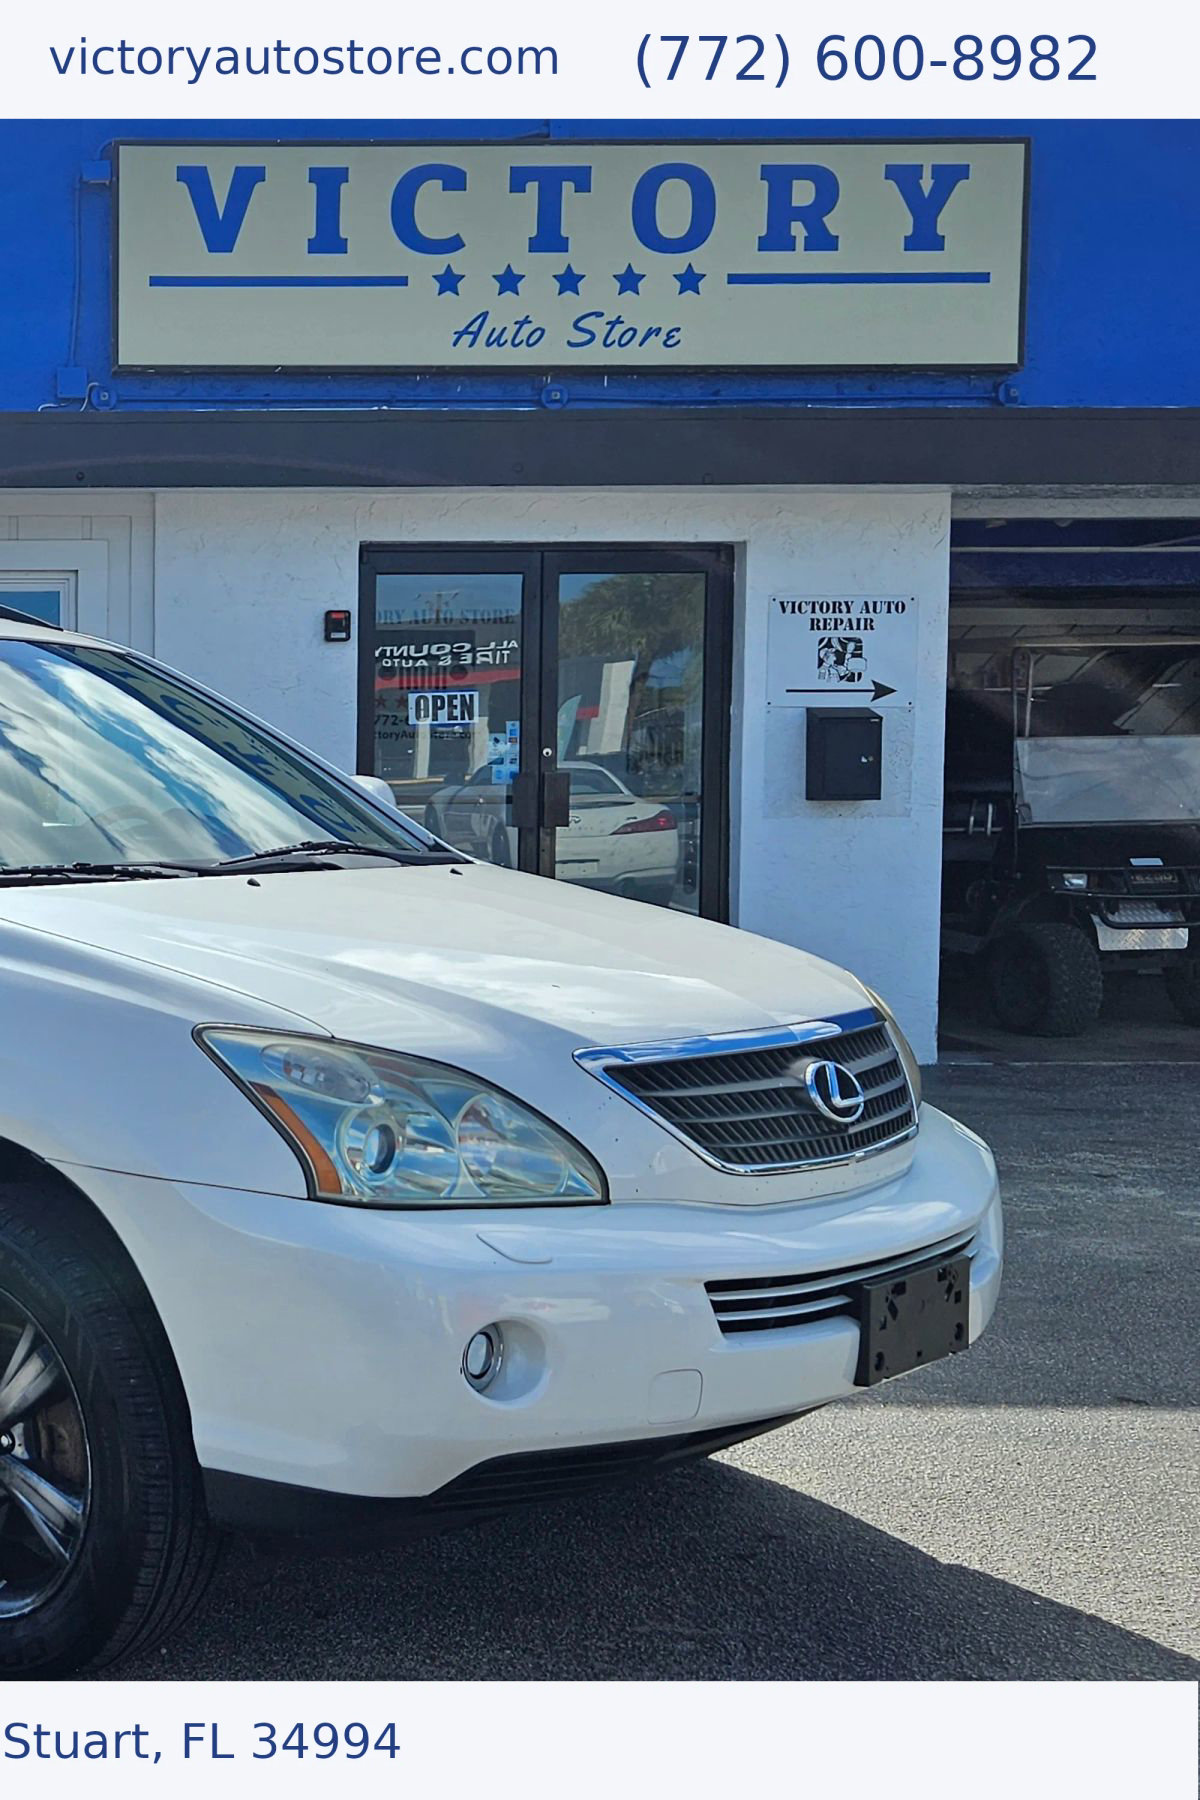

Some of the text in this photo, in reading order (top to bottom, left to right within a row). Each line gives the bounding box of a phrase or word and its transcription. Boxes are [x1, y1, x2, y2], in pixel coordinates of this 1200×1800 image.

[175, 162, 971, 256] VICTORY
[452, 310, 682, 349] Auto Store
[409, 608, 454, 625] AUTO
[459, 608, 515, 625] STORE
[778, 600, 907, 615] VICTORY AUTO
[809, 617, 876, 632] REPAIR
[415, 694, 475, 722] OPEN
